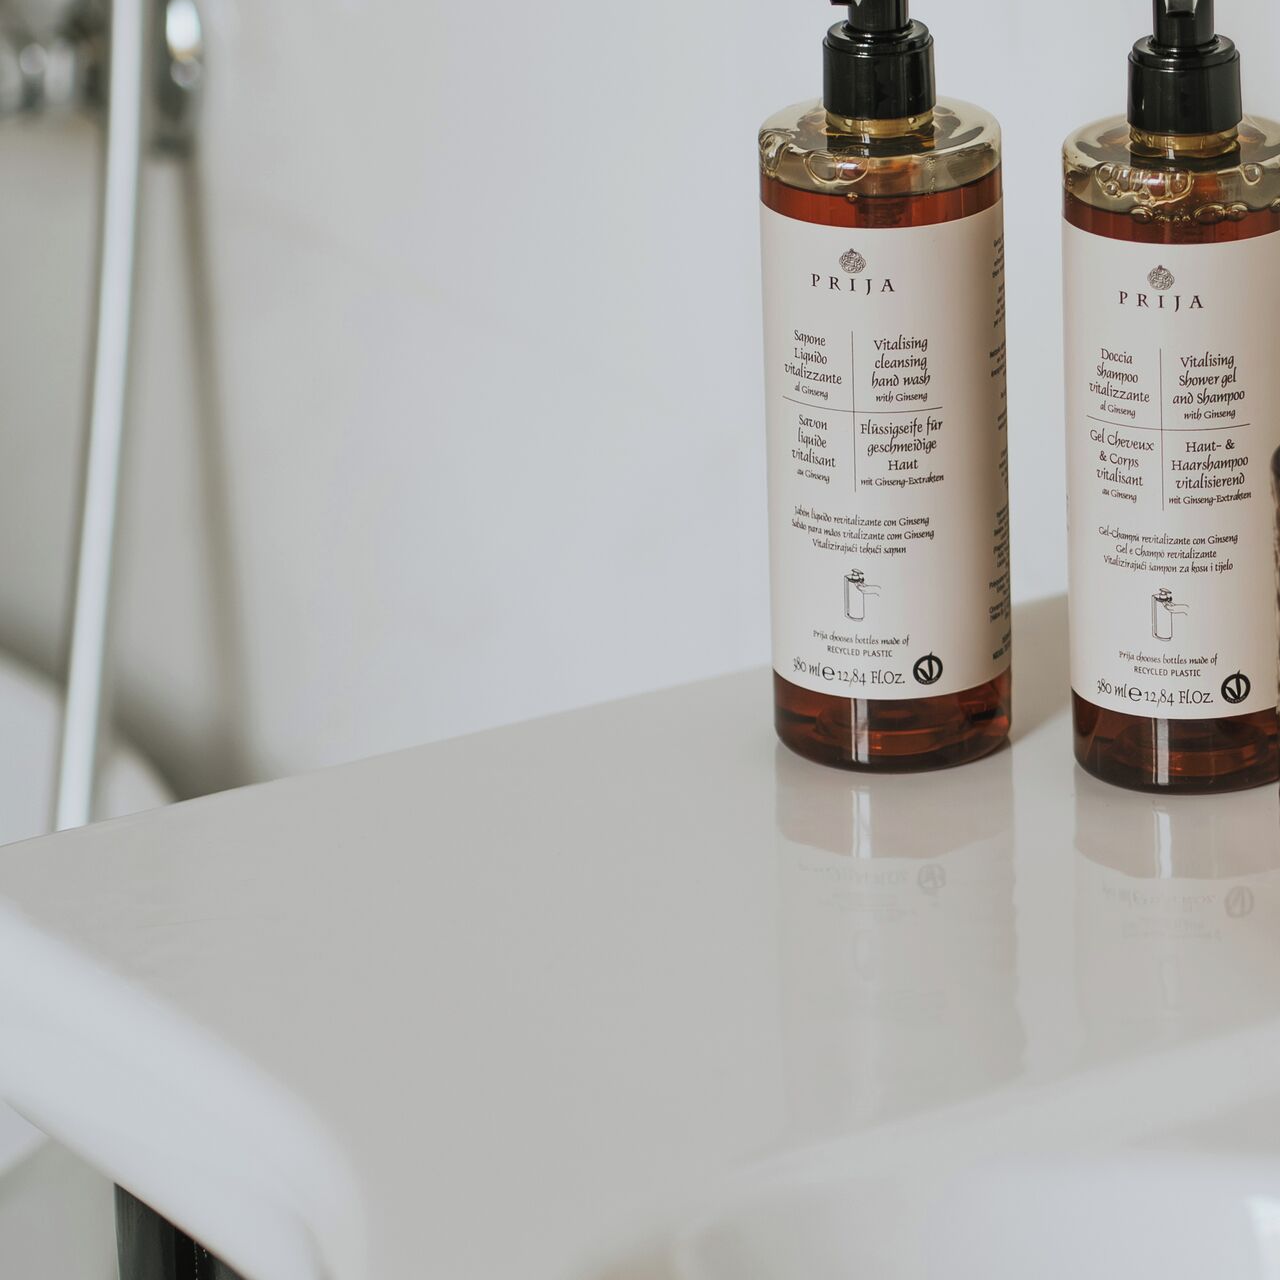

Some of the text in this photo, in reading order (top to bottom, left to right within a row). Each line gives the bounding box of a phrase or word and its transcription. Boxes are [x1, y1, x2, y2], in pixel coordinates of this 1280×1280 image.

[811, 273, 895, 296] PRIJA
[1119, 291, 1204, 312] PRIJA
[794, 330, 826, 346] Sapone
[874, 335, 928, 351] Vitalising
[794, 348, 828, 365] Liquido
[875, 353, 927, 370] cleansing
[1101, 348, 1133, 364] Doccia
[1181, 353, 1234, 369] Vitalising
[785, 362, 842, 385] vitalizzante
[871, 370, 931, 388] hand wash
[1097, 362, 1138, 385] Shampoo
[1179, 367, 1237, 387] Shower gel
[802, 385, 828, 400] Ginseng
[876, 391, 928, 403] with Ginseng
[1089, 381, 1150, 403] vitalizzante
[1173, 389, 1245, 408] and Shampoo
[1108, 404, 1136, 418] Ginseng
[1184, 408, 1235, 420] with Ginseng
[799, 414, 828, 430] Savon
[860, 419, 923, 439] Flüssigseife
[798, 428, 827, 448] liquide
[1090, 429, 1154, 451] Gel Cheveux
[1186, 439, 1235, 453] Haut- &
[868, 437, 937, 456] geschmeidige
[792, 448, 836, 468] vitalisant
[888, 459, 918, 471] Haut
[1099, 452, 1139, 470] & Corps
[1172, 455, 1248, 472] Haarshampoo
[805, 470, 830, 484] Ginseng
[1097, 468, 1143, 487] vitalisant
[1176, 473, 1245, 489] vitalisierend
[1111, 490, 1137, 503] Ginseng
[834, 515, 881, 526] revitalizante
[899, 516, 930, 526] Ginseng
[843, 528, 884, 540] vitalizante
[904, 530, 934, 540] Ginseng
[1142, 534, 1190, 545] revitalizante
[1208, 534, 1238, 545] Ginseng
[884, 546, 906, 556] sapun
[1116, 543, 1128, 554] Gel
[1167, 547, 1216, 559] revitalizante
[1192, 561, 1208, 574] kosu
[1215, 559, 1233, 573] tijelo
[855, 634, 879, 645] bottles
[902, 634, 910, 646] of
[827, 645, 892, 657] RECYCLED PLASTIC
[1163, 654, 1187, 664] bottles
[1210, 653, 1218, 665] of
[793, 657, 806, 672] 380
[1134, 666, 1167, 676] RECYCLED
[1097, 679, 1111, 693] 380
